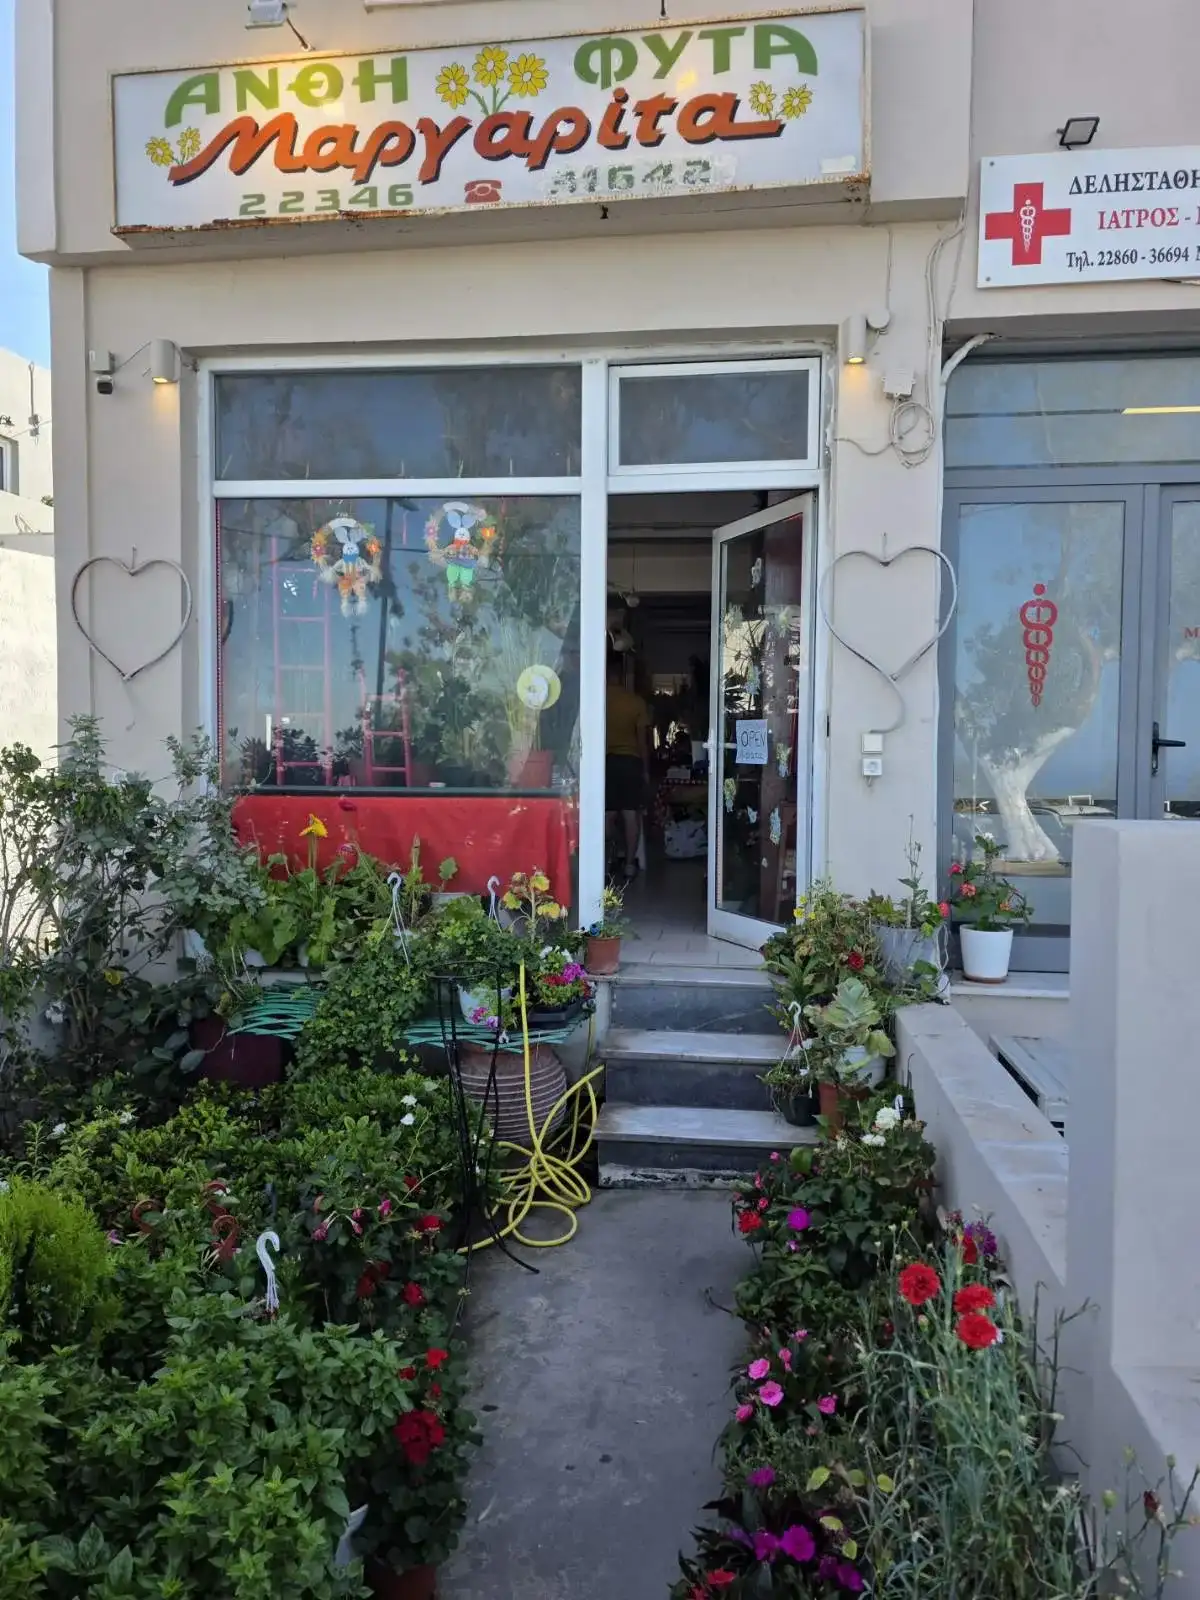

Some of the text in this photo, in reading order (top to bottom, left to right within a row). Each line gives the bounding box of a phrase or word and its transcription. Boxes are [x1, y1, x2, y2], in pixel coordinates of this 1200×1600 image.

[164, 24, 818, 129] ΑΝΘΗ ΦΥΤΑ
[239, 183, 414, 216] 22346
[1098, 207, 1180, 230] ΙΑΤΡΟΣ
[1066, 251, 1094, 272] Τηλ.
[1098, 249, 1138, 266] 22860
[1149, 246, 1190, 264] 36694
[741, 731, 767, 747] OPEN
